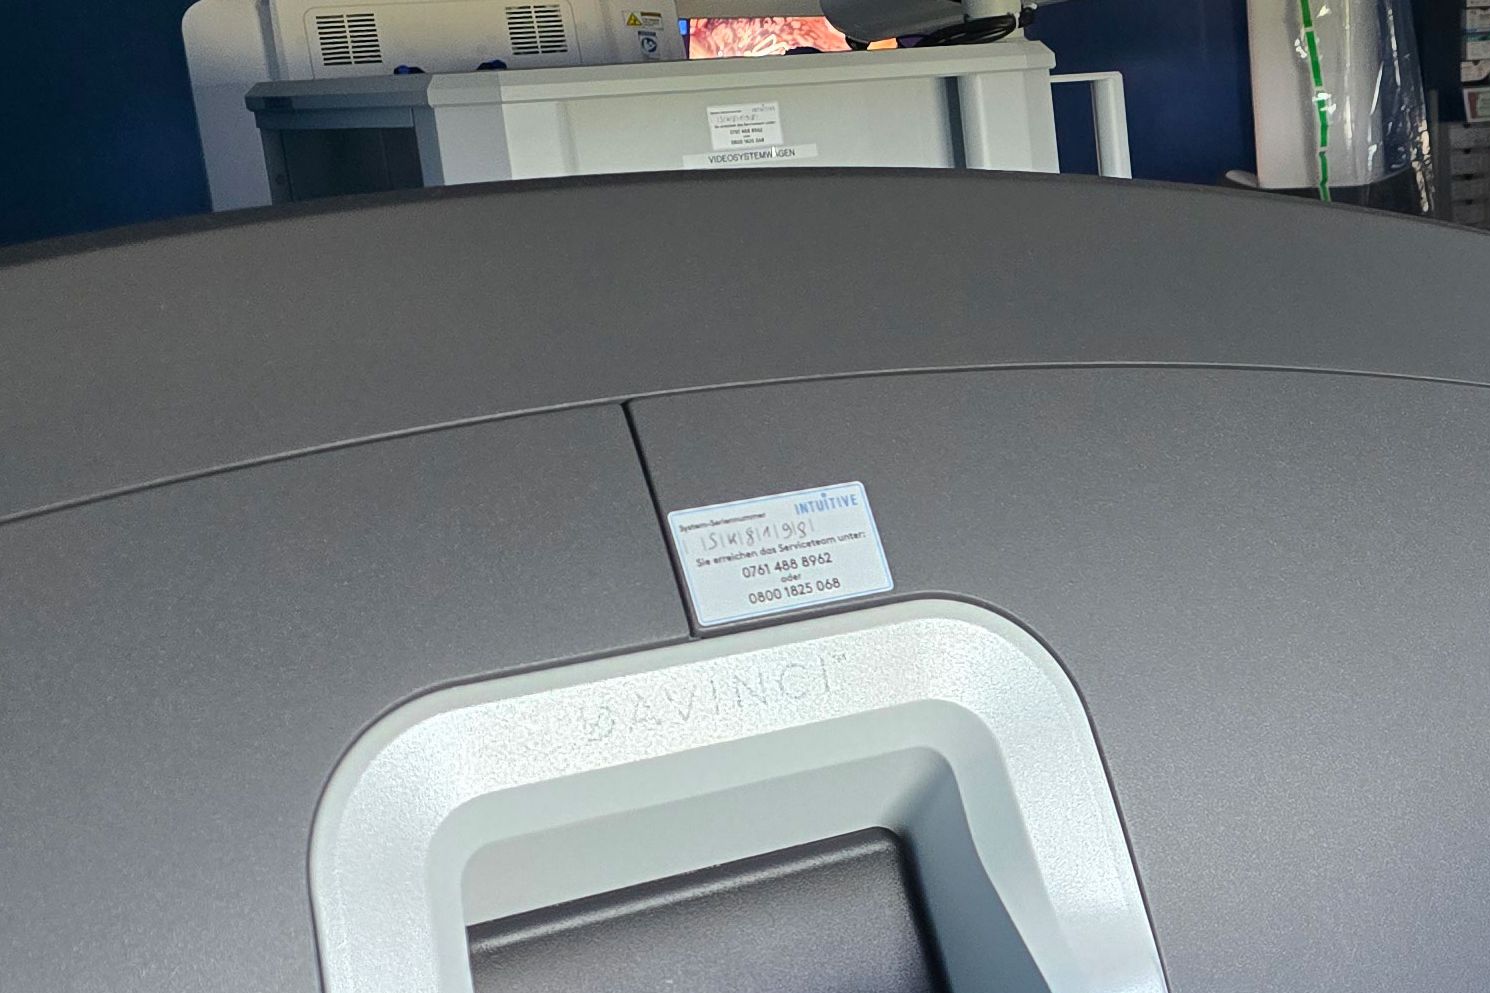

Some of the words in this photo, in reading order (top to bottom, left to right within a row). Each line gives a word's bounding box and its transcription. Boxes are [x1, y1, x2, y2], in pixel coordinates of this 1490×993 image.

[794, 492, 859, 515] INTUITIVE
[696, 557, 711, 567] Sie
[713, 550, 758, 564] erreichen
[760, 546, 777, 556] das
[778, 536, 837, 553] Serviceteam
[837, 530, 867, 542] unter:
[742, 563, 771, 578] 0761
[774, 558, 798, 572] 488
[801, 552, 833, 568] 8962
[781, 573, 801, 583] oder
[748, 588, 782, 604] 0800
[784, 582, 813, 598] 1825
[816, 577, 841, 592] 068
